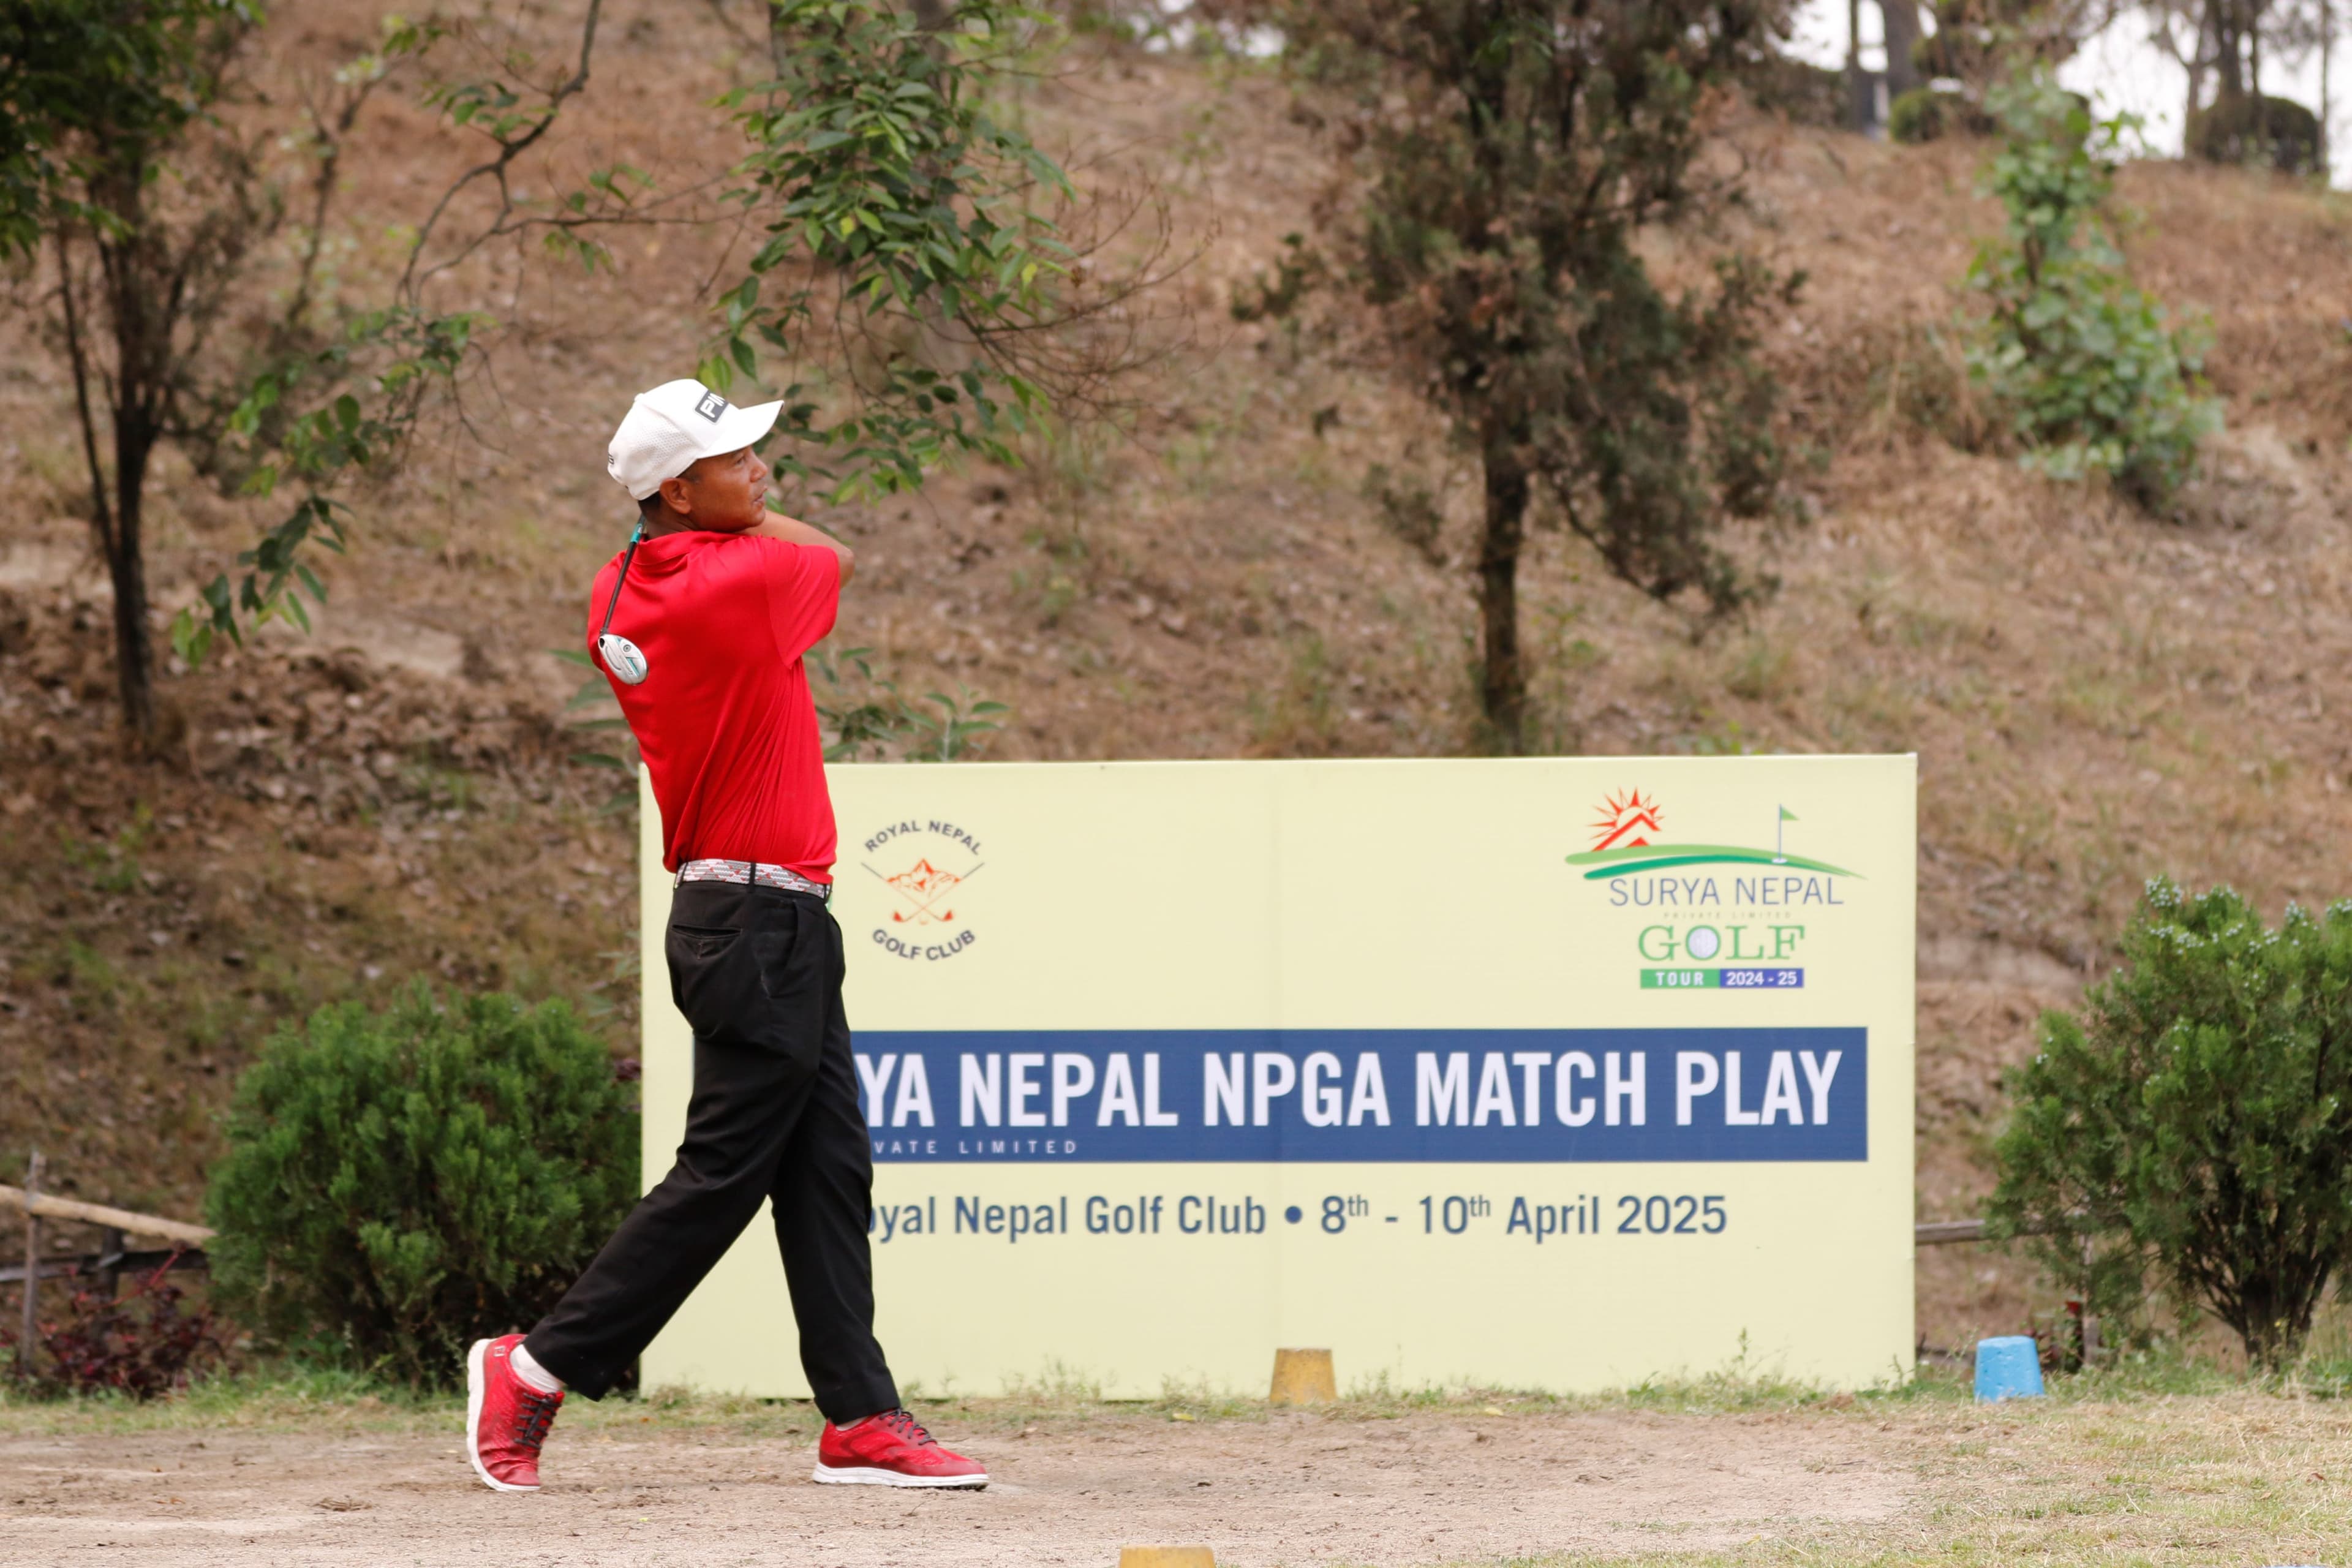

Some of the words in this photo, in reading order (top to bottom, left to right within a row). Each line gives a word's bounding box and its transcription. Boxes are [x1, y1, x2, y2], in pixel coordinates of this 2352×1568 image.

[864, 820, 921, 852] ROYAL
[928, 820, 981, 855] NEPAL
[1610, 877, 1720, 906] SURYA
[1736, 876, 1844, 905] NEPAL
[872, 929, 922, 960] GOLF
[925, 929, 976, 961] CLUB
[1638, 924, 1806, 962] GOLF
[1656, 971, 1704, 986] TOUR
[1726, 971, 1765, 986] 2024
[1778, 971, 1798, 986] 25
[960, 1052, 1178, 1127] NEPAL
[1204, 1051, 1391, 1128] NPGA
[1415, 1050, 1646, 1127] MATCH
[1676, 1050, 1842, 1126] PLAY
[873, 1140, 937, 1154] VATE
[959, 1140, 1077, 1154] LIMITED
[955, 1196, 1067, 1244] Nepal
[1085, 1195, 1163, 1234] Golf
[1178, 1195, 1266, 1234] Club
[1321, 1194, 1369, 1234] 8th
[1419, 1194, 1491, 1235] 10th
[1506, 1194, 1599, 1245] April
[1617, 1195, 1727, 1234] 2025
